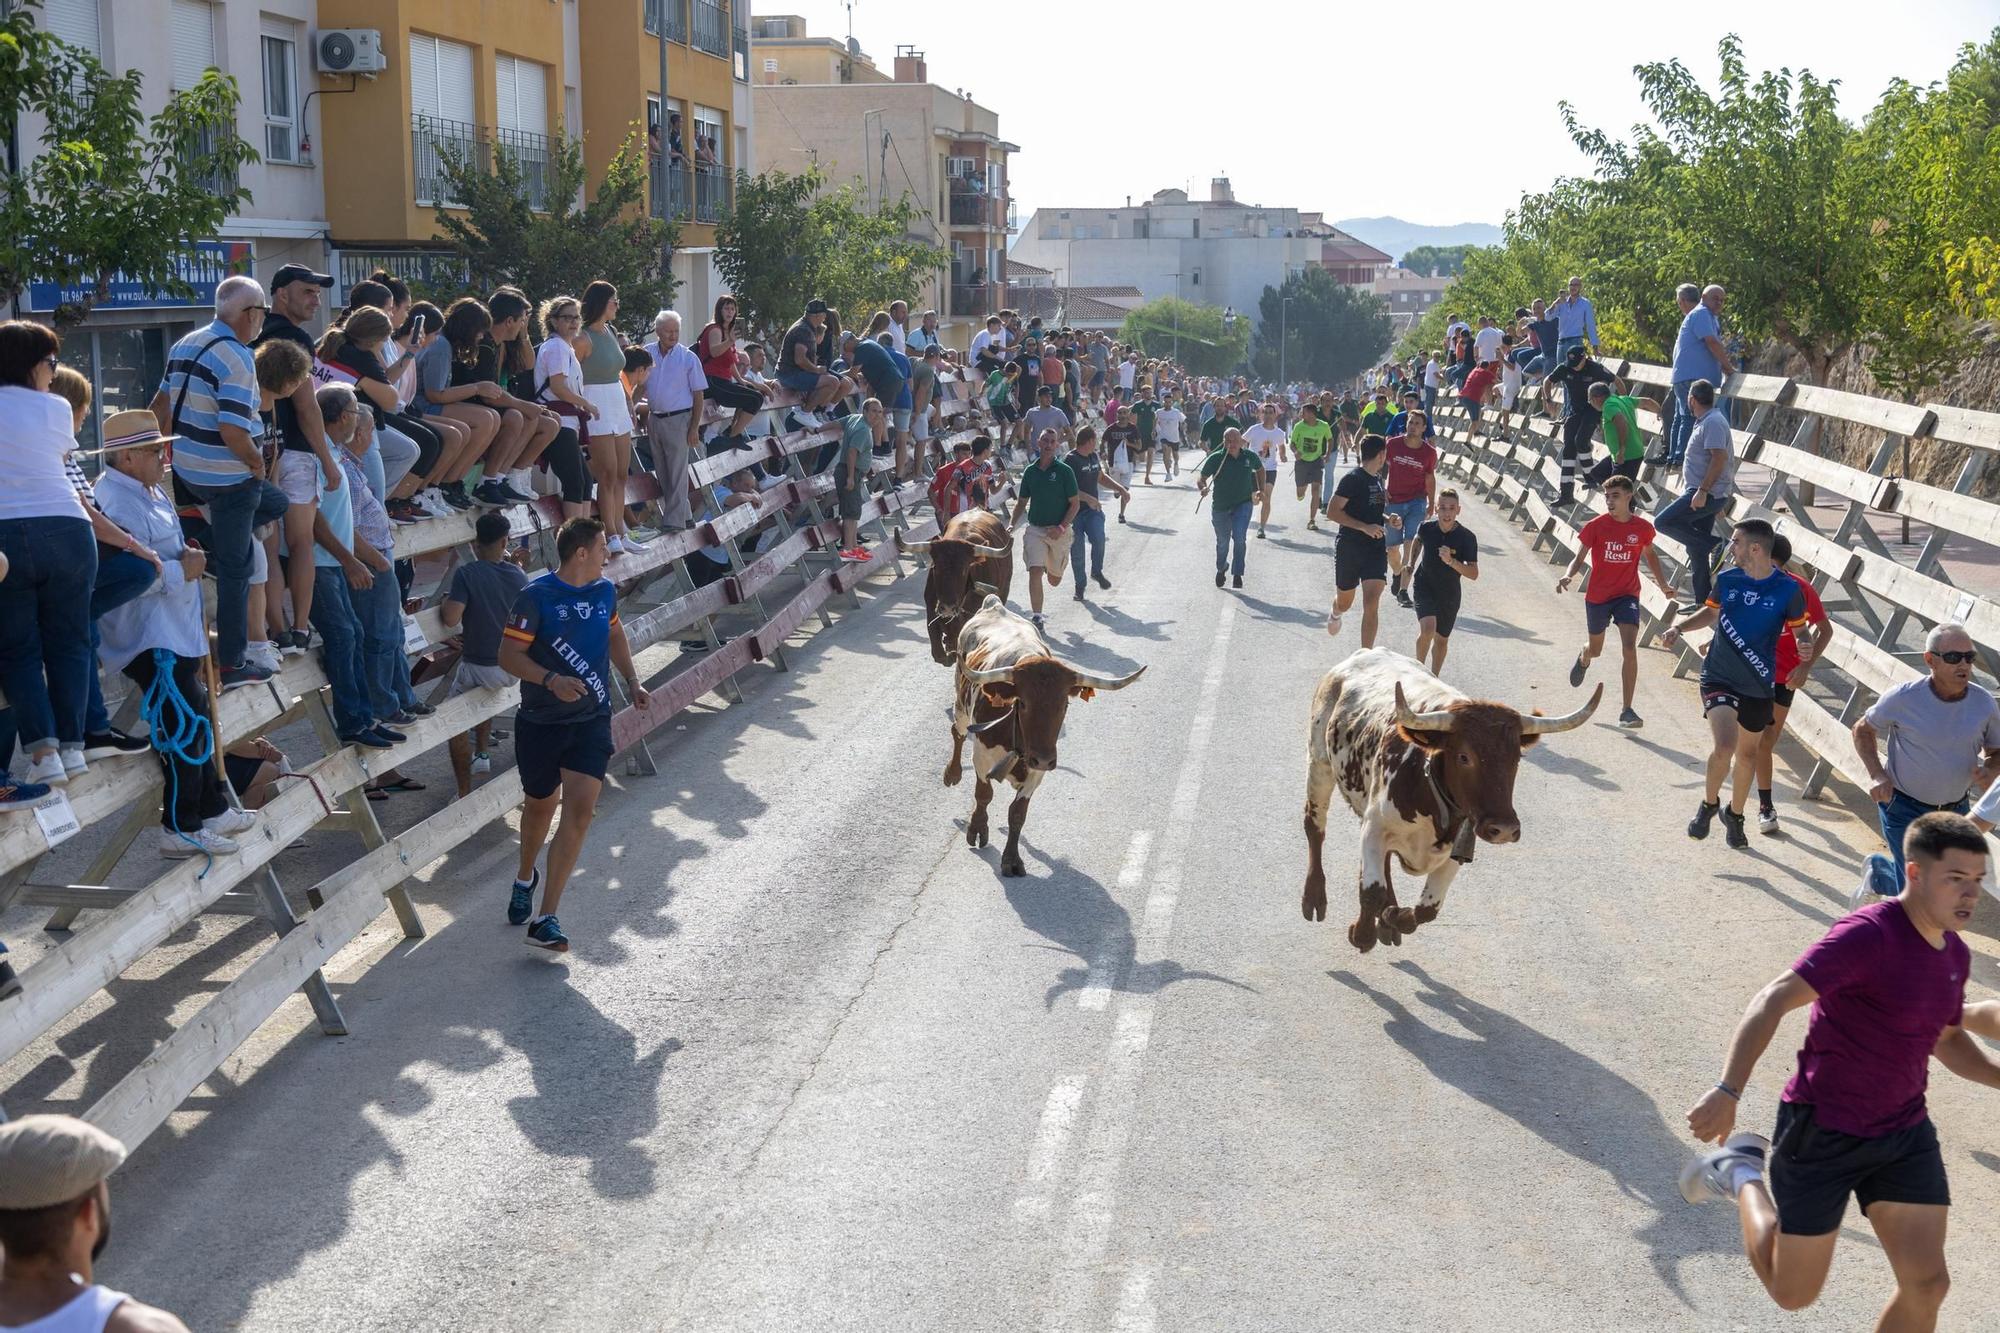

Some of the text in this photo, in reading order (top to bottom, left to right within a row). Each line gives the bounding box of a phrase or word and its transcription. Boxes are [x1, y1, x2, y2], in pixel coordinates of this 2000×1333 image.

[341, 256, 423, 286] AUTOVILES
[1604, 541, 1623, 551] Tío
[1604, 550, 1632, 560] Resti
[551, 637, 589, 675] LETUR
[1720, 613, 1769, 677] LETUR 2023
